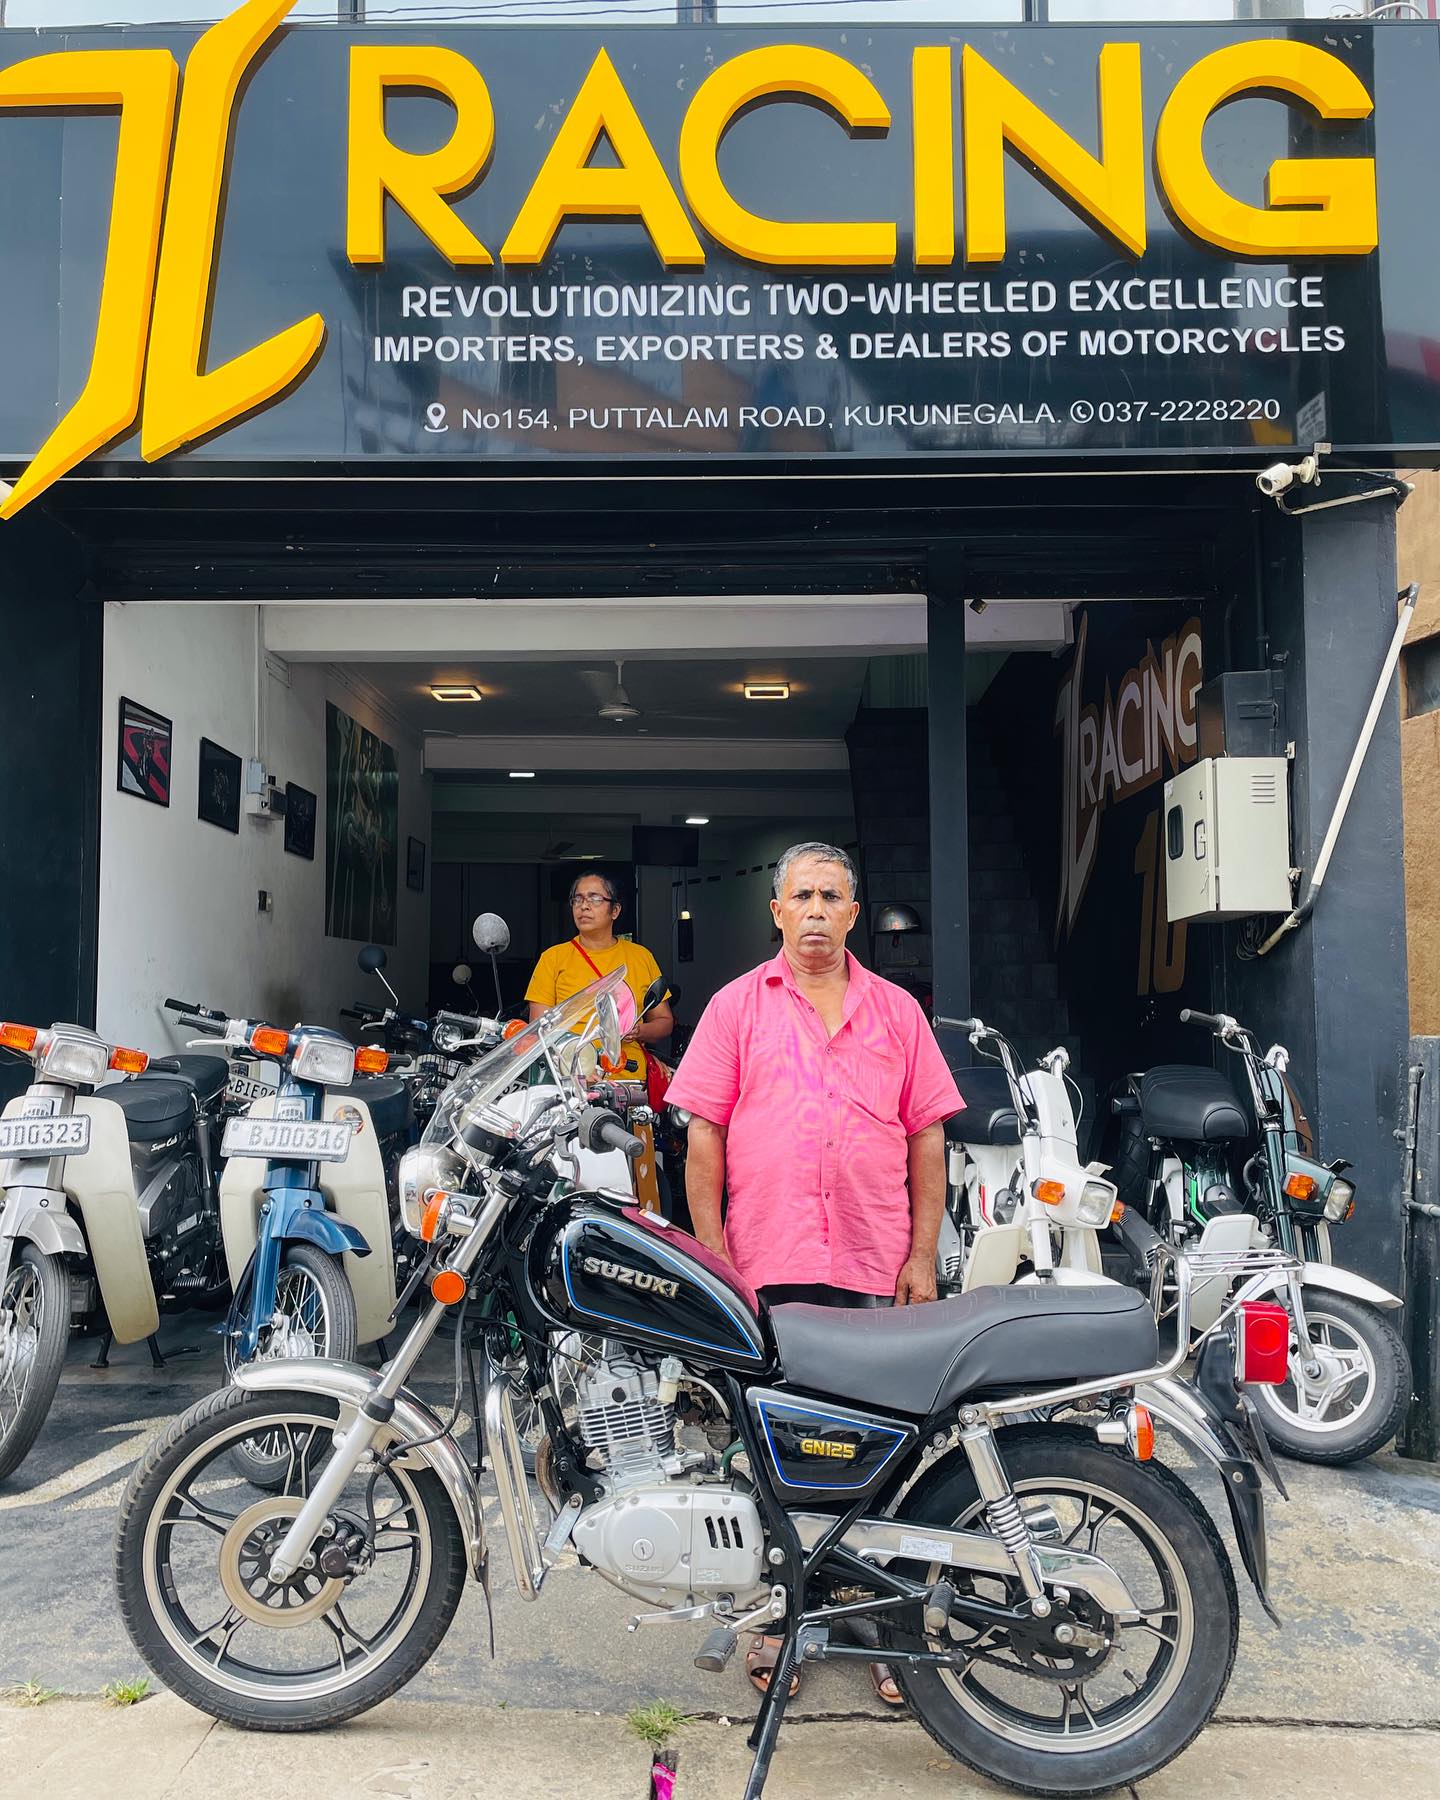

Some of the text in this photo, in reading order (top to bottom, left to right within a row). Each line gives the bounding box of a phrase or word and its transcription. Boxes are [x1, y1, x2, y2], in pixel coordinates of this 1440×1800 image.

[346, 39, 1378, 266] RACING
[402, 276, 1325, 317] REVOLUTIONIZING TWO-WHEELED EXCELLENCE
[374, 326, 1346, 364] IMPORTERS, EXPORTERS & DEALERS OF MOTORCYCLES
[462, 408, 558, 431] No154,
[569, 406, 728, 429] PUTTALAM
[739, 406, 834, 428] ROAD,
[844, 402, 1062, 426] KURUNEGALA.
[1098, 399, 1281, 423] 037-2228220
[1079, 632, 1203, 811] RACING
[583, 1256, 680, 1299] SUZUKI
[800, 1438, 857, 1460] GN125
